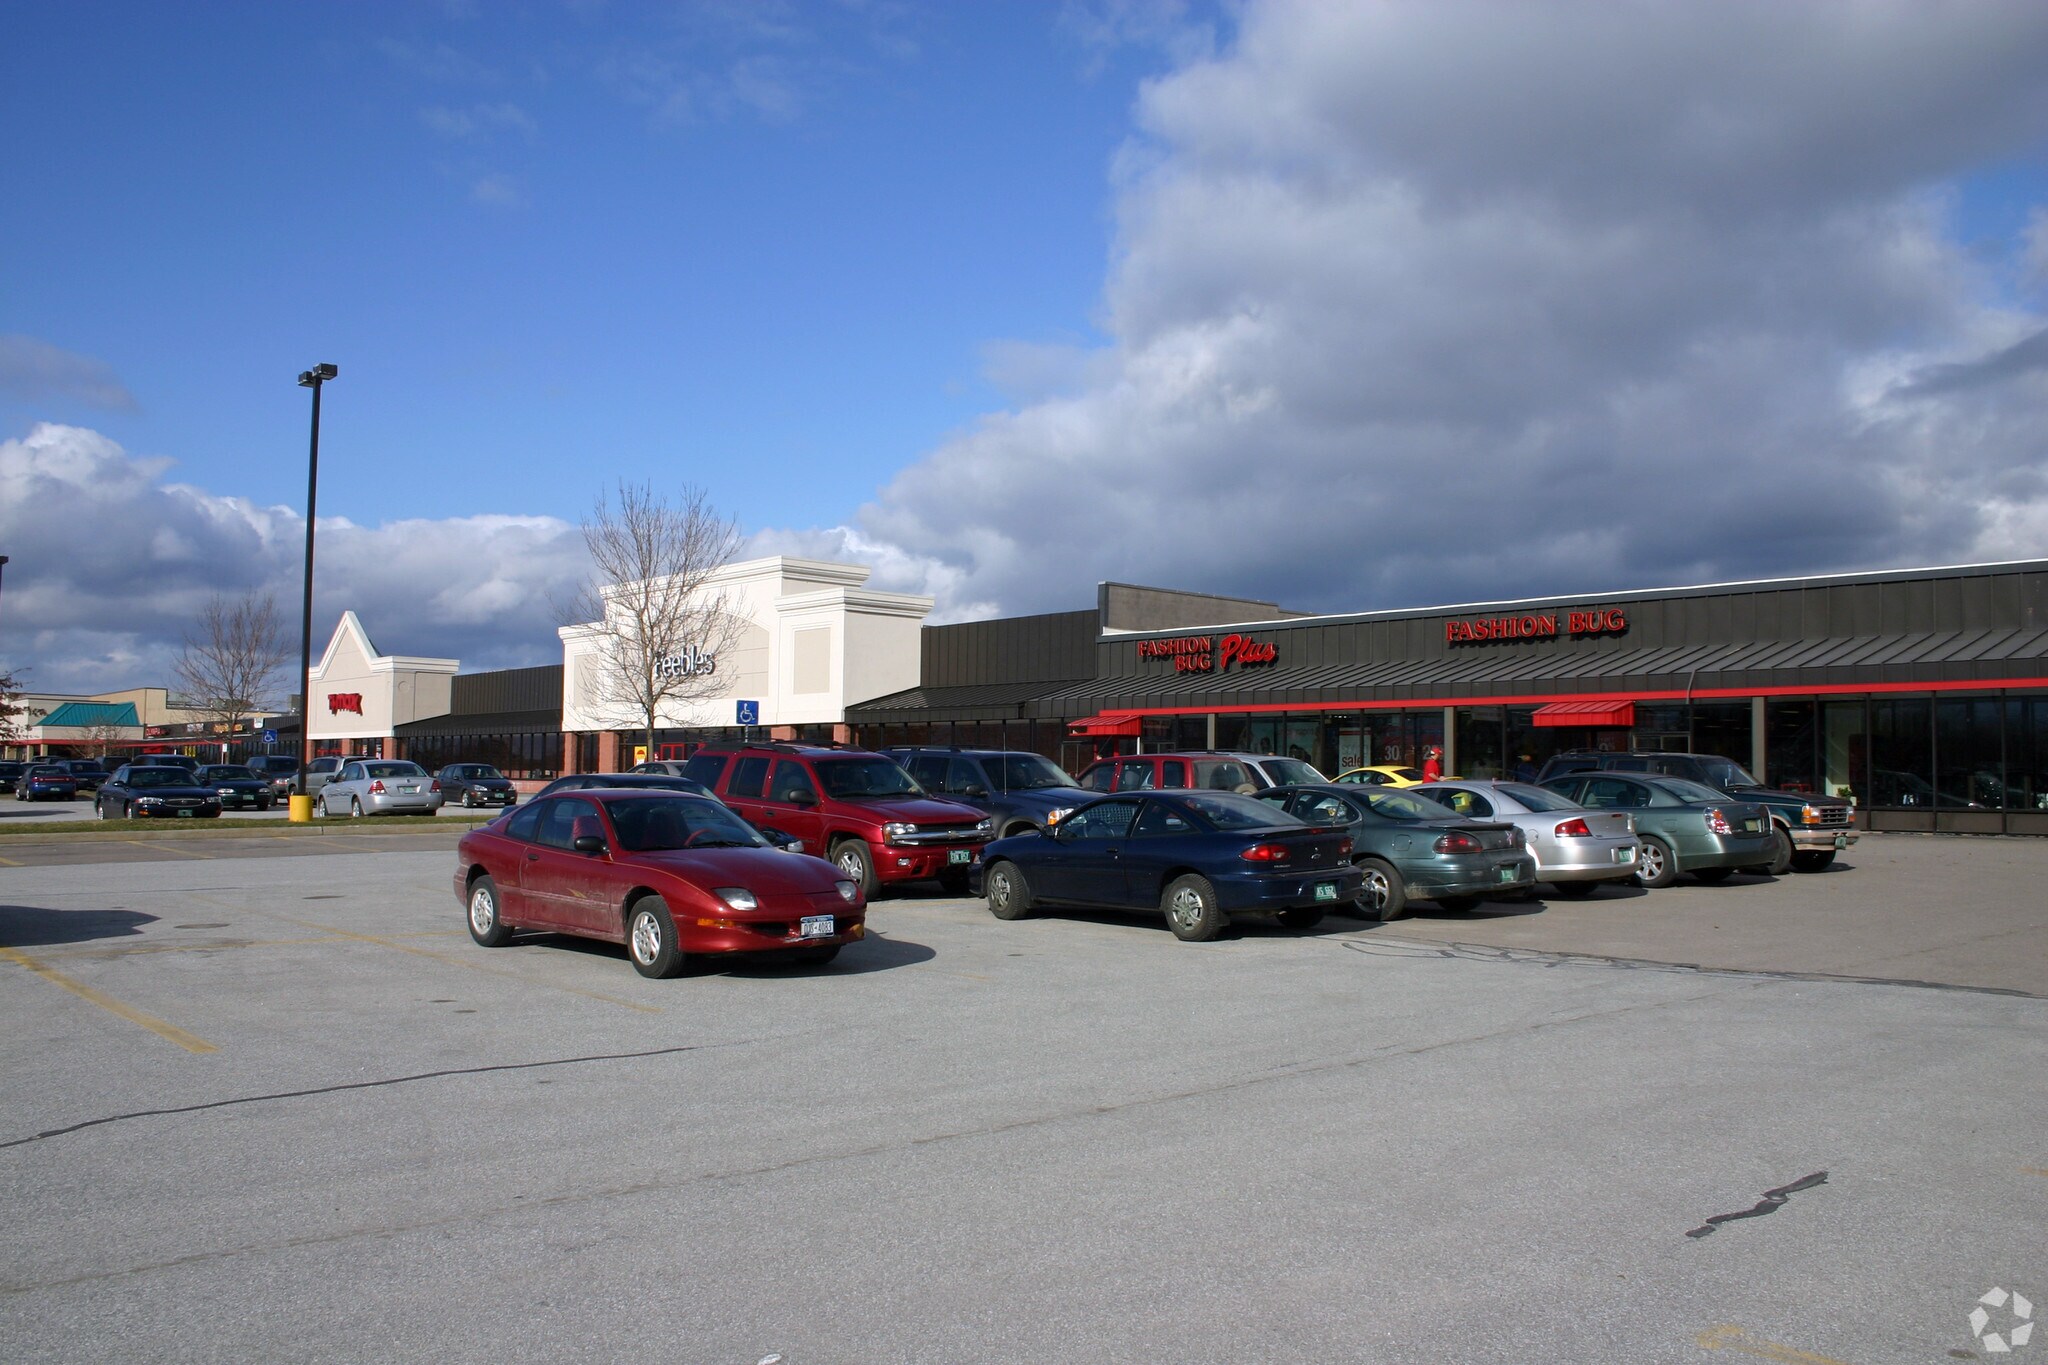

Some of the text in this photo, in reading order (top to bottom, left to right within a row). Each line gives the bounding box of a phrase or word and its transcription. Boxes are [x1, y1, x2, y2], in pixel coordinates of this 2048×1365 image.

[1445, 608, 1626, 642] FASHION BUG
[1137, 633, 1277, 669] FASHION Plus
[1174, 653, 1212, 672] BUG
